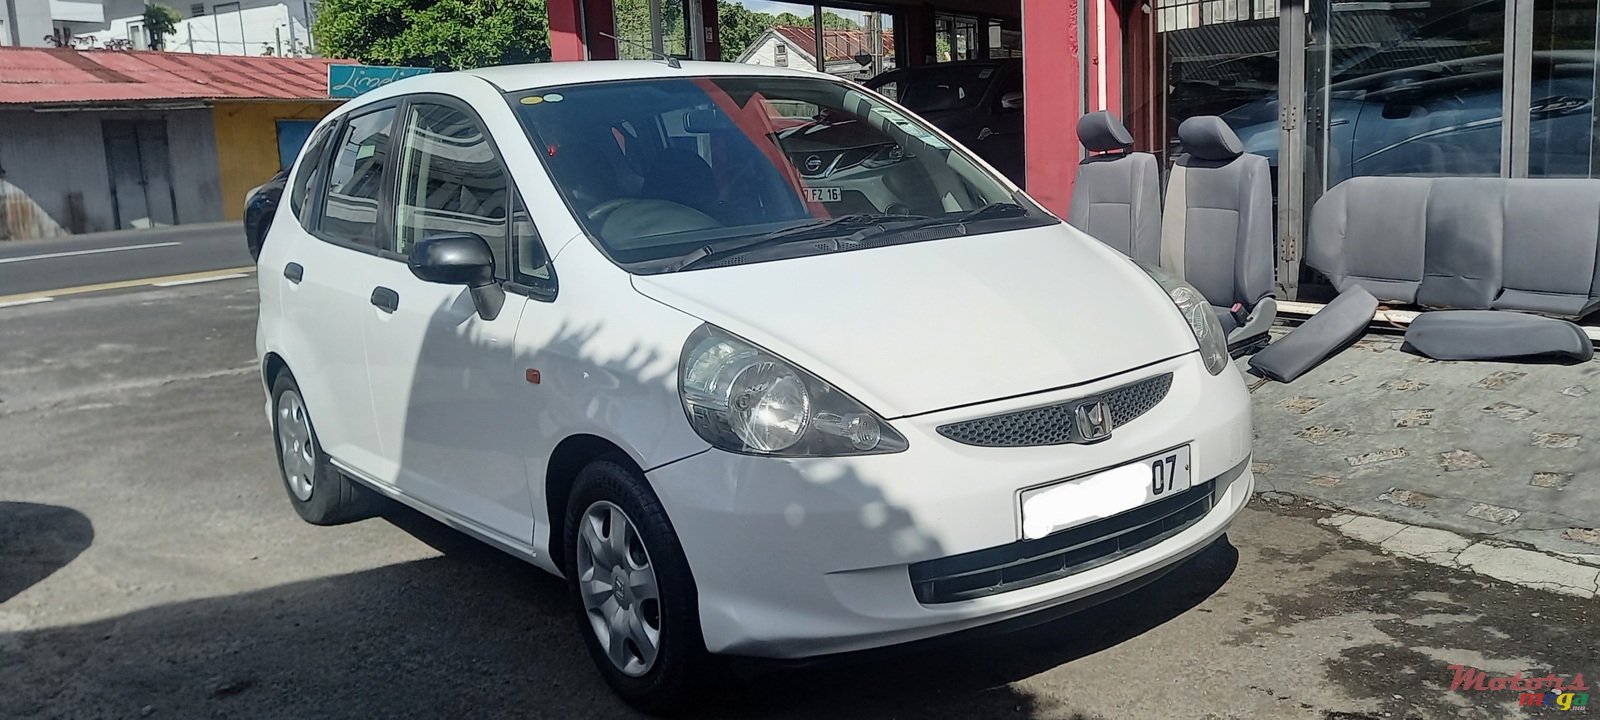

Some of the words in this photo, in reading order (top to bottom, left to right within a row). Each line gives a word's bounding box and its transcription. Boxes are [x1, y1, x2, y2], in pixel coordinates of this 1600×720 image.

[812, 189, 823, 200] FZ
[827, 189, 838, 200] 16
[1152, 454, 1177, 496] 07
